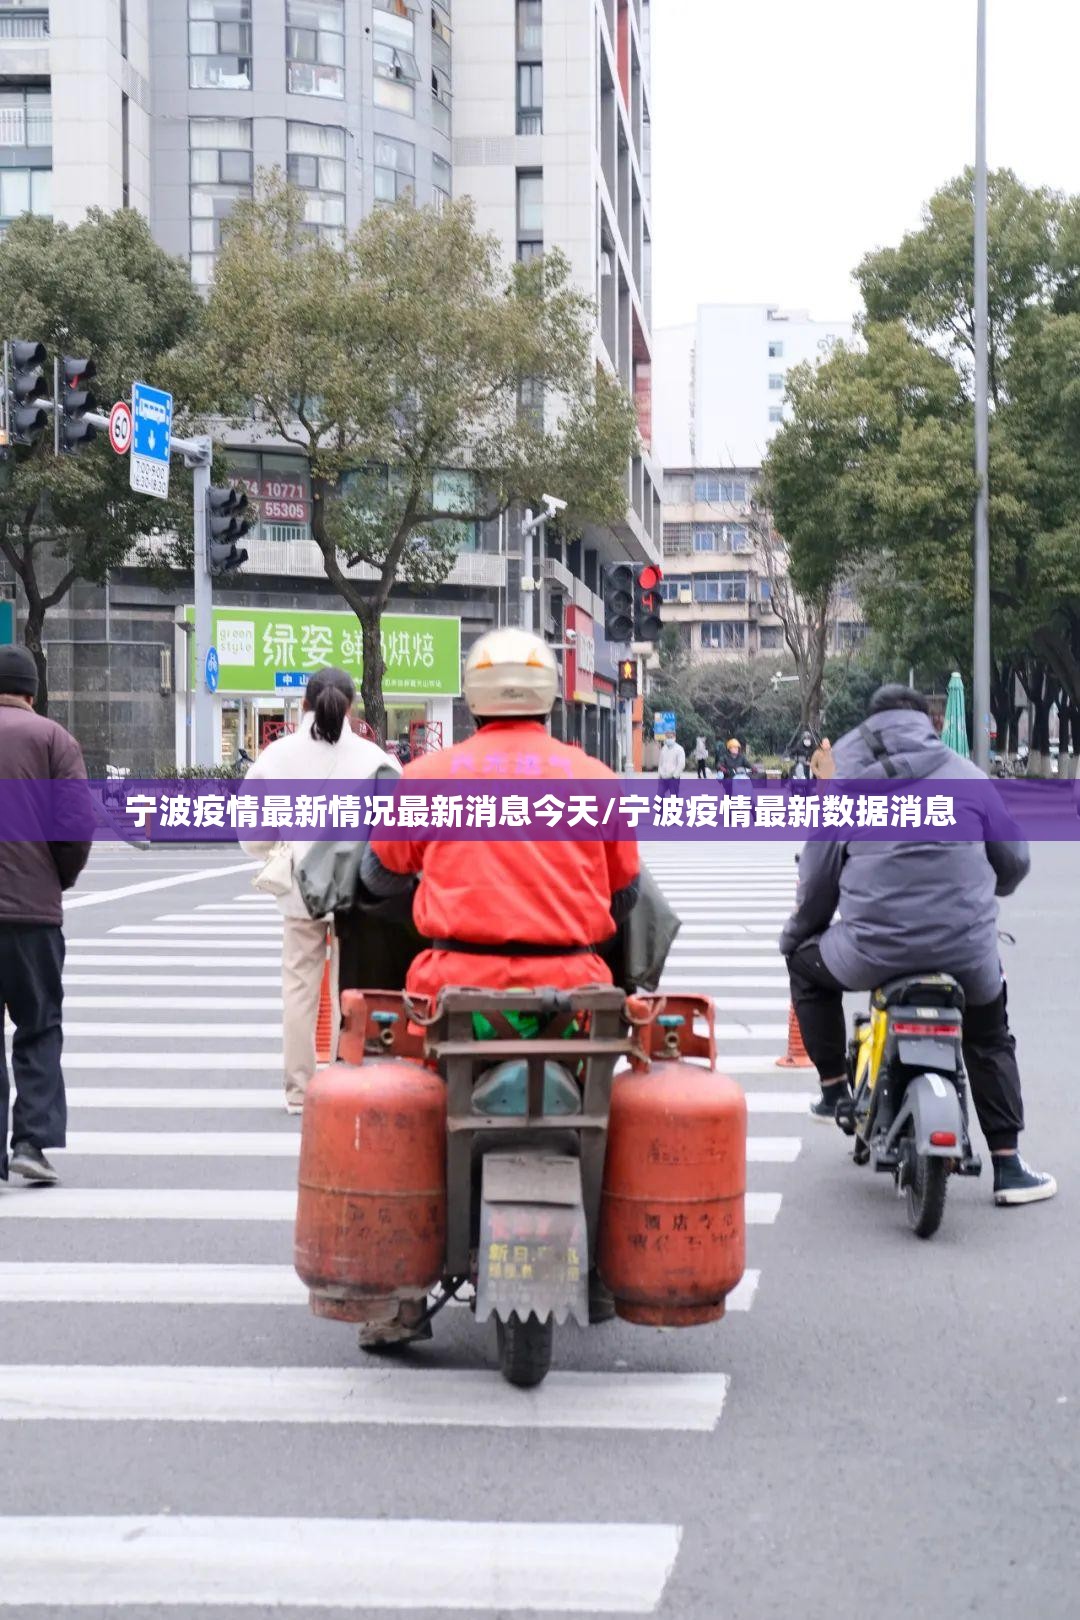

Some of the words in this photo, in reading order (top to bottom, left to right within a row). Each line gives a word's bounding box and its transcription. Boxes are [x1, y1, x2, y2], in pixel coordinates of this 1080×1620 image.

[115, 416, 128, 439] 60
[266, 482, 304, 498] 10771
[265, 502, 304, 518] 55305
[262, 622, 333, 667] 绿姿
[341, 629, 434, 668] 鲜烘焙
